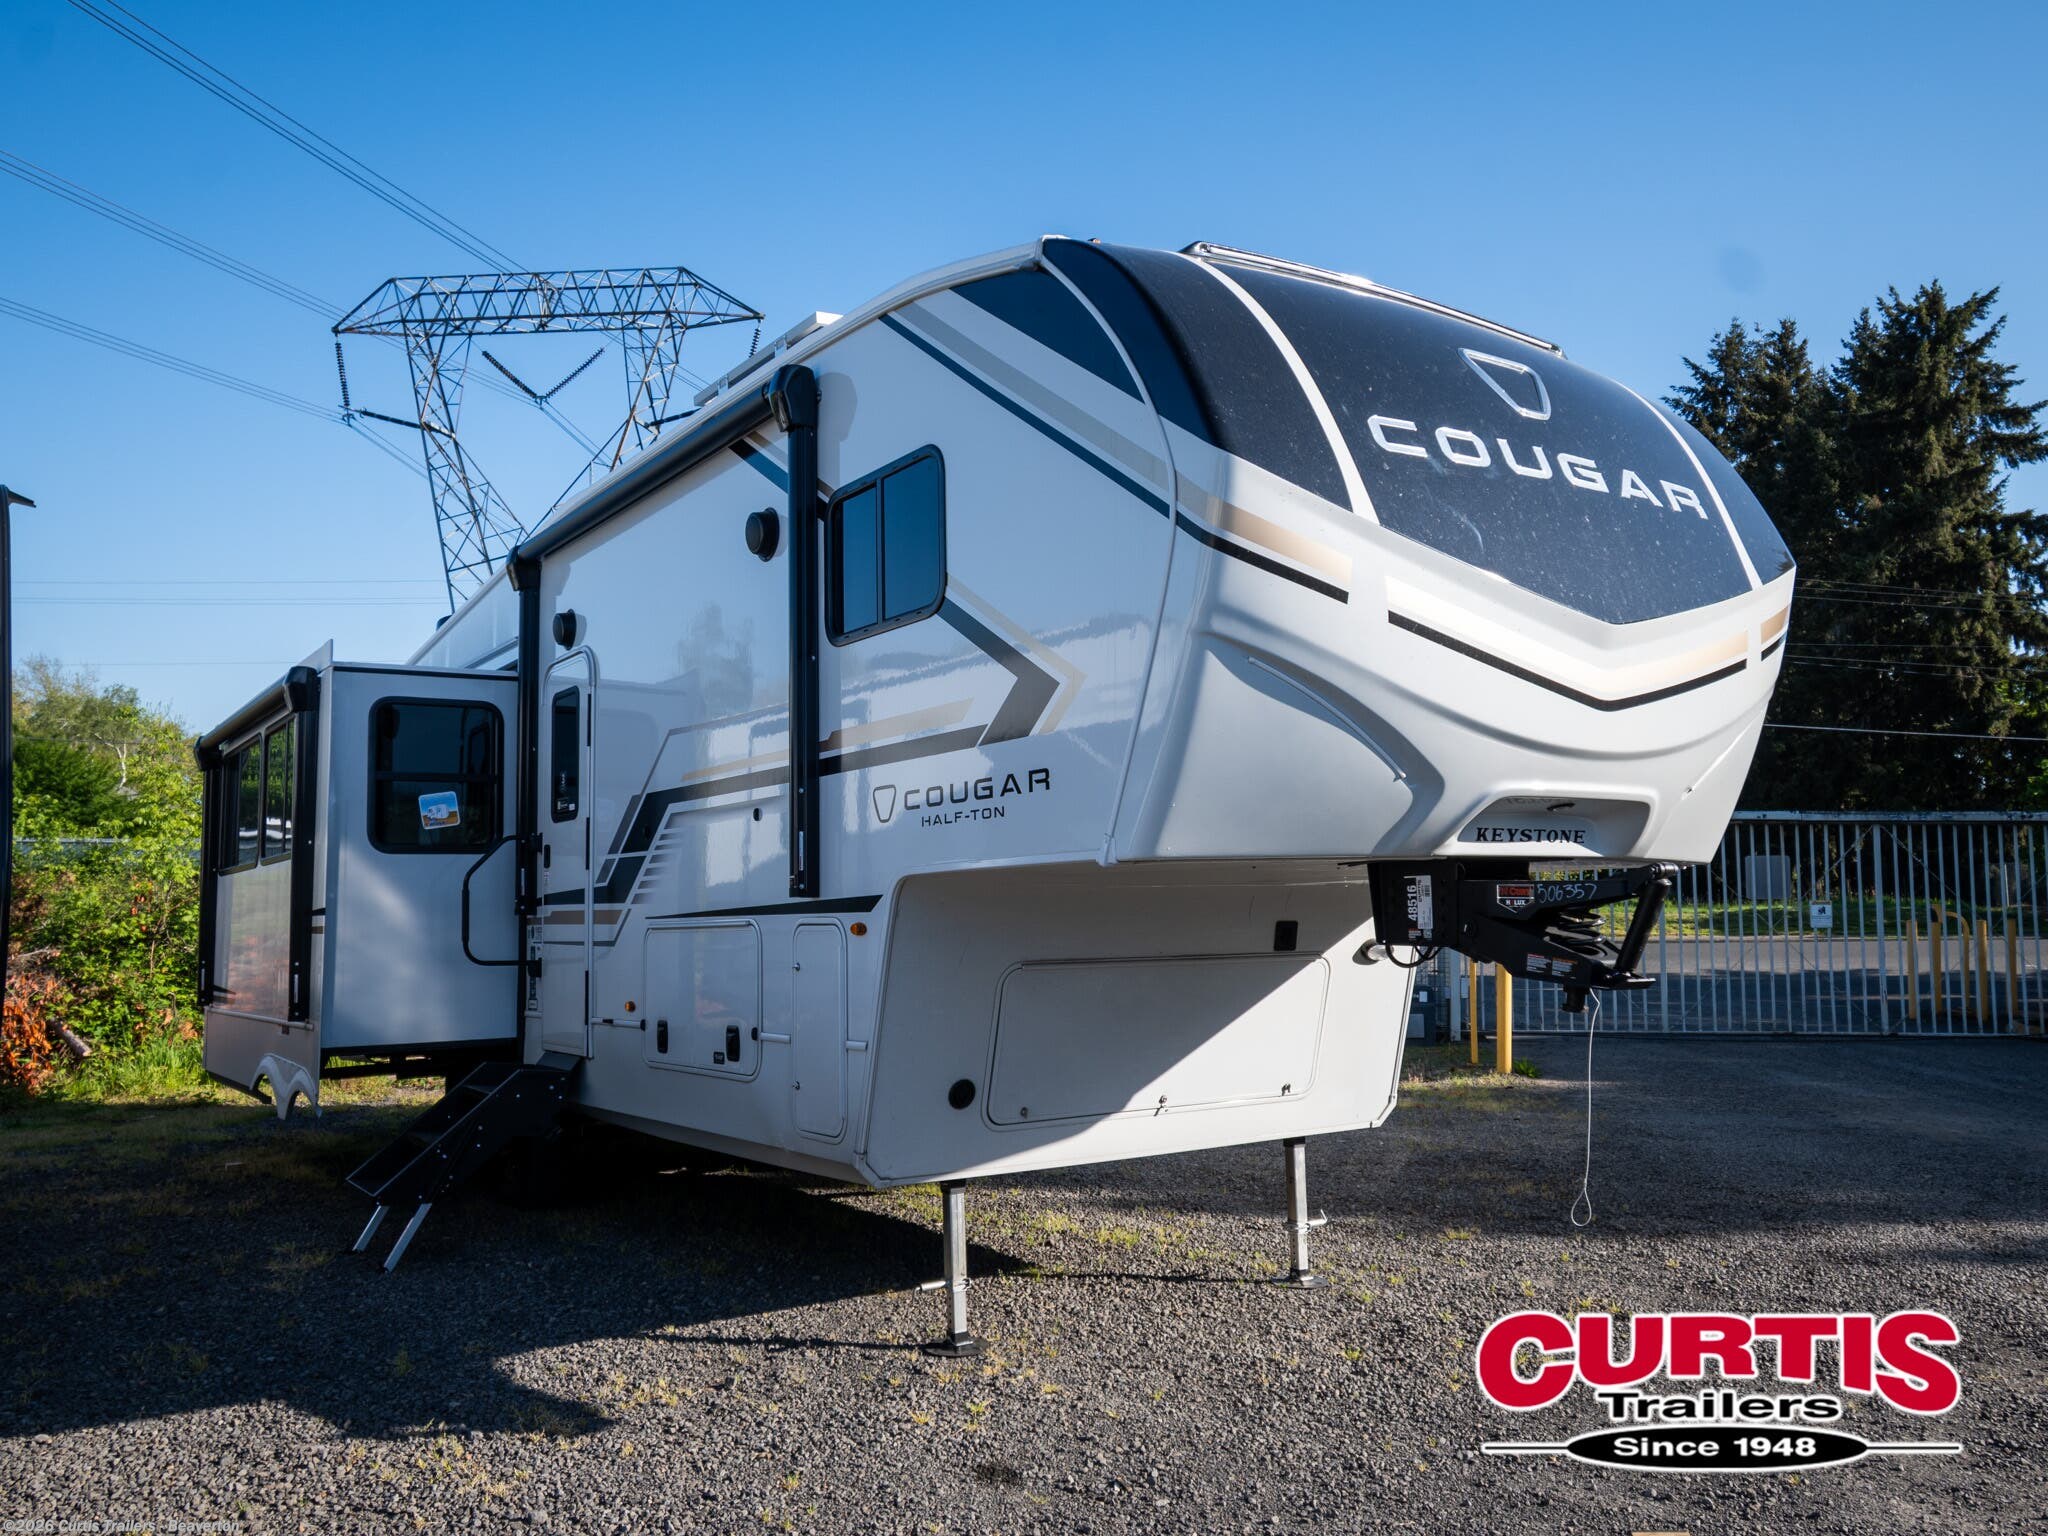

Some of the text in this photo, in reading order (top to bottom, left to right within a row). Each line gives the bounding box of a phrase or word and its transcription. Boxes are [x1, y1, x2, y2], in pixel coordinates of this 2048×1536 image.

[1367, 413, 1709, 520] COUGAR
[904, 768, 1050, 811] COUGAR
[921, 806, 1005, 828] HALF-TON
[1476, 827, 1585, 843] KEYSTONE
[1407, 885, 1418, 921] 48516
